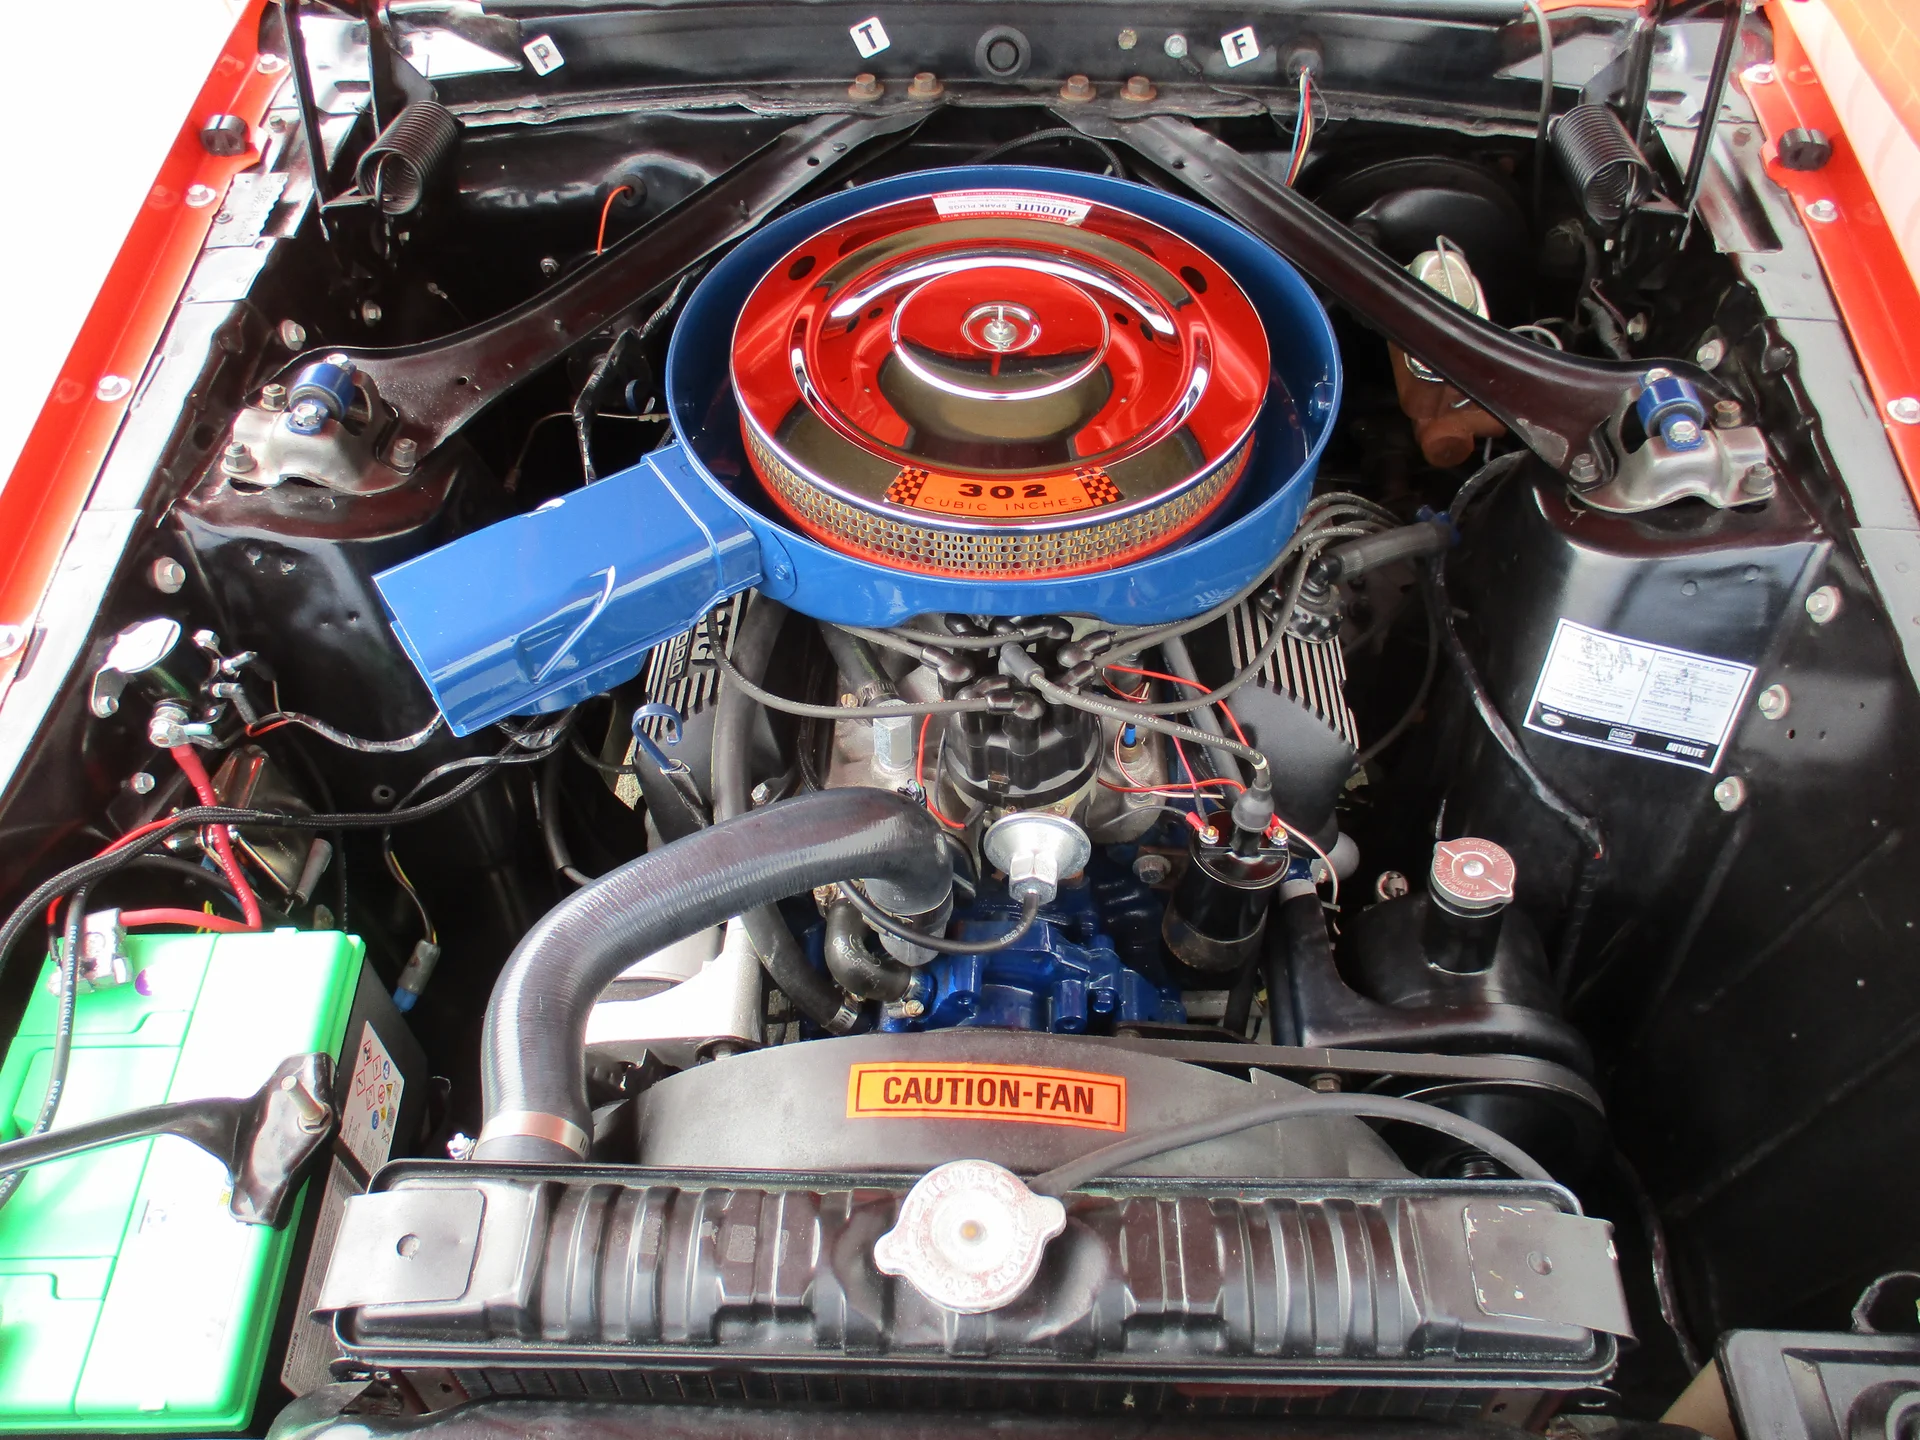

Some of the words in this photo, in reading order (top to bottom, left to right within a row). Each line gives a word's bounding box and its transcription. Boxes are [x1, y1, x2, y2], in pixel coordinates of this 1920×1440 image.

[858, 24, 877, 51] T
[1231, 33, 1249, 60] F
[532, 43, 550, 69] P
[1015, 203, 1076, 216] AUTOLITE
[958, 483, 1048, 499] 302
[923, 496, 988, 511] CUBIC
[1005, 496, 1083, 511] INCHES
[1082, 697, 1119, 713] AUTOLITE
[1175, 724, 1224, 744] RESISTANCE
[1665, 741, 1707, 759] AUTOLITE
[61, 992, 73, 1036] AUTOLITE
[883, 1076, 1094, 1114] CAUTION-FAN
[284, 1332, 299, 1378] DANGER
